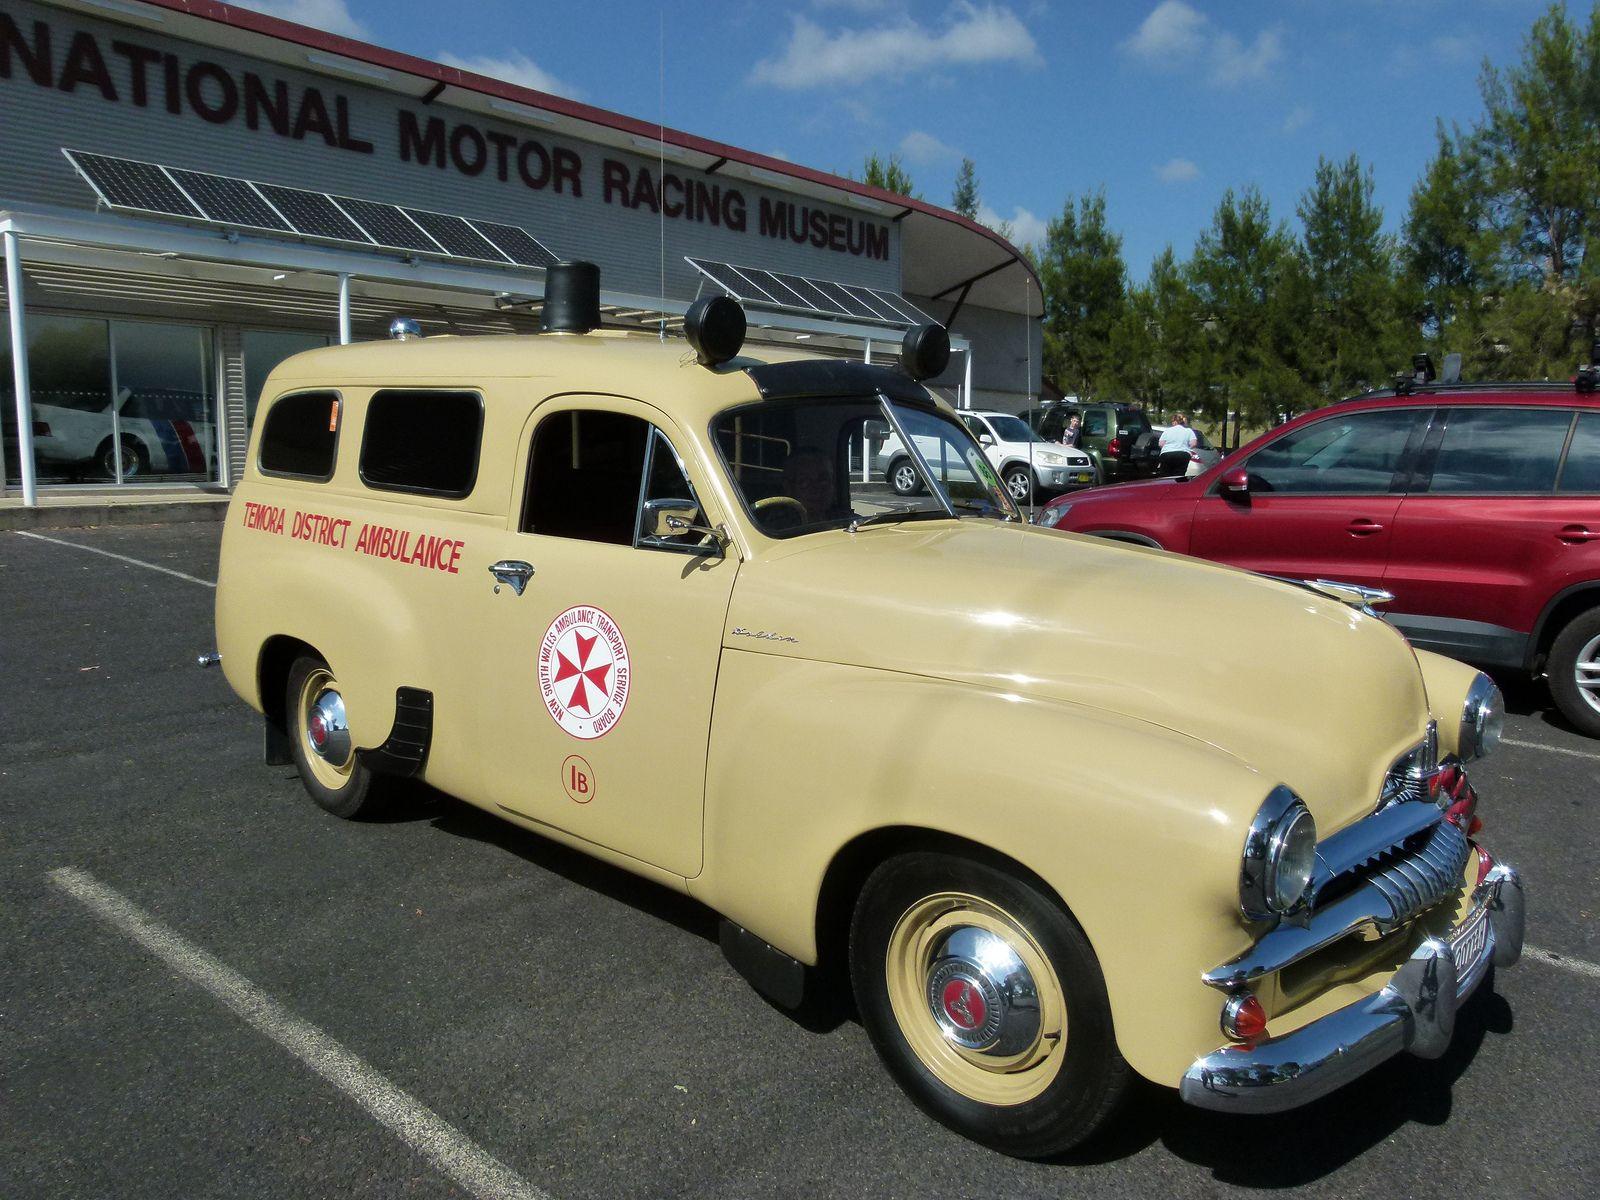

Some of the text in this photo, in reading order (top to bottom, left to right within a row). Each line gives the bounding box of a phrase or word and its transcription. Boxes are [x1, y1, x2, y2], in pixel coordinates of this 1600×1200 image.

[0, 12, 890, 261] NATIONAL MOTOR RACING MUSEUM
[243, 502, 465, 574] TEMORA DISTRICT AMBULANCE
[540, 609, 627, 733] NEW SOUTH WALES AMBULANCE TRANSPORT SERVICE BOARD
